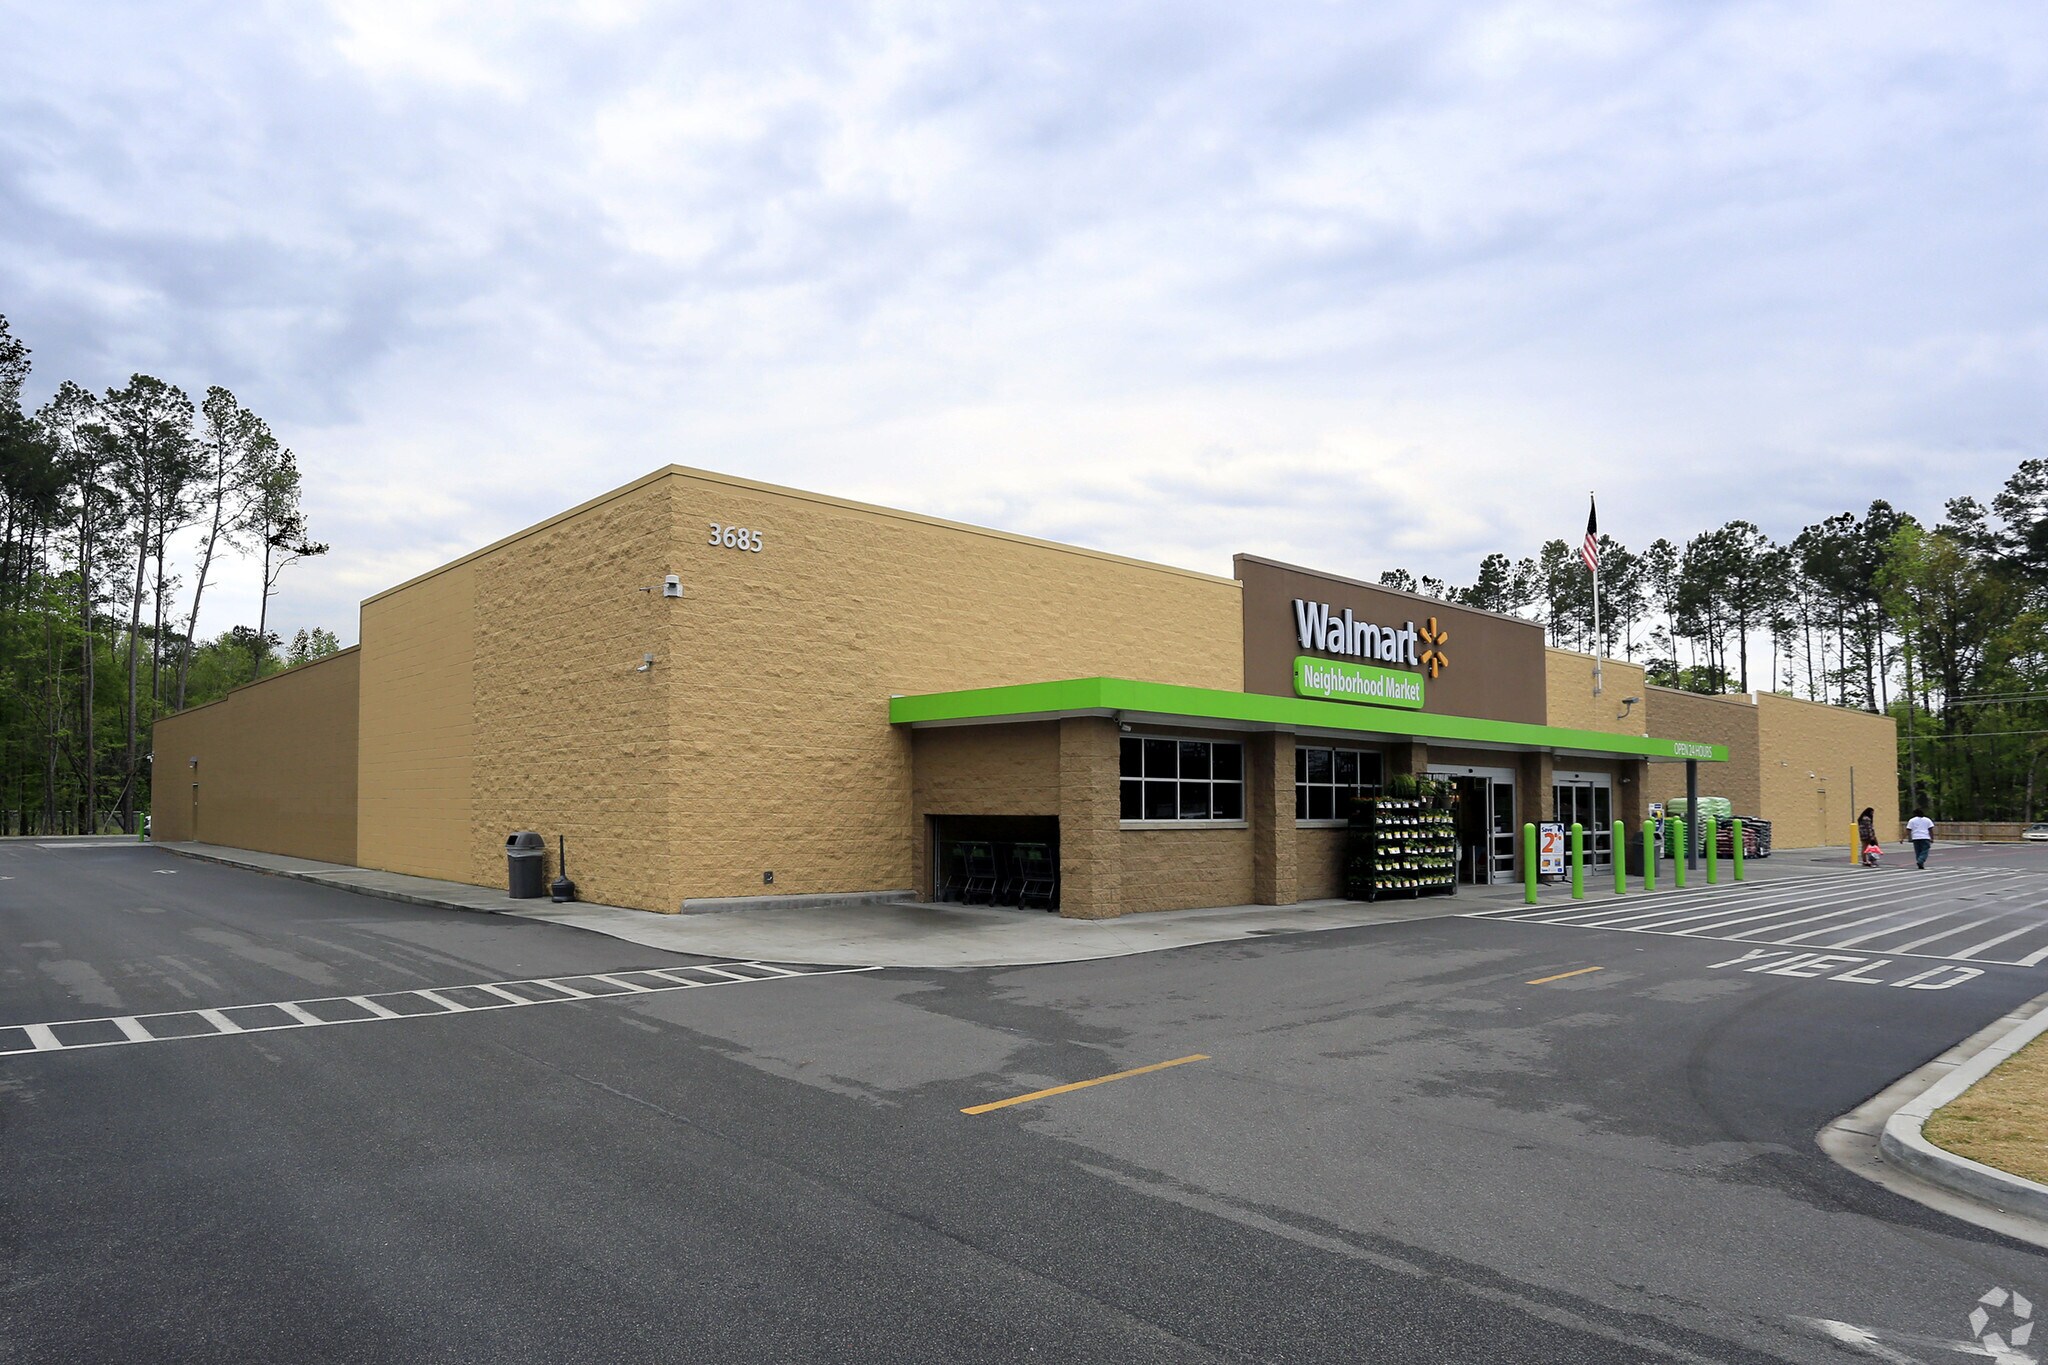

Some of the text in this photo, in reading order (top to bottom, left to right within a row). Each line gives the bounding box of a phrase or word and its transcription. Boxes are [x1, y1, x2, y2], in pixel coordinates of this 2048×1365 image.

[708, 522, 763, 553] 3685
[1294, 598, 1418, 666] Walmart
[1304, 664, 1420, 701] Neighborhood Market
[1674, 742, 1712, 758] OPEN 24 HOURS
[1706, 948, 1985, 990] YIELD
